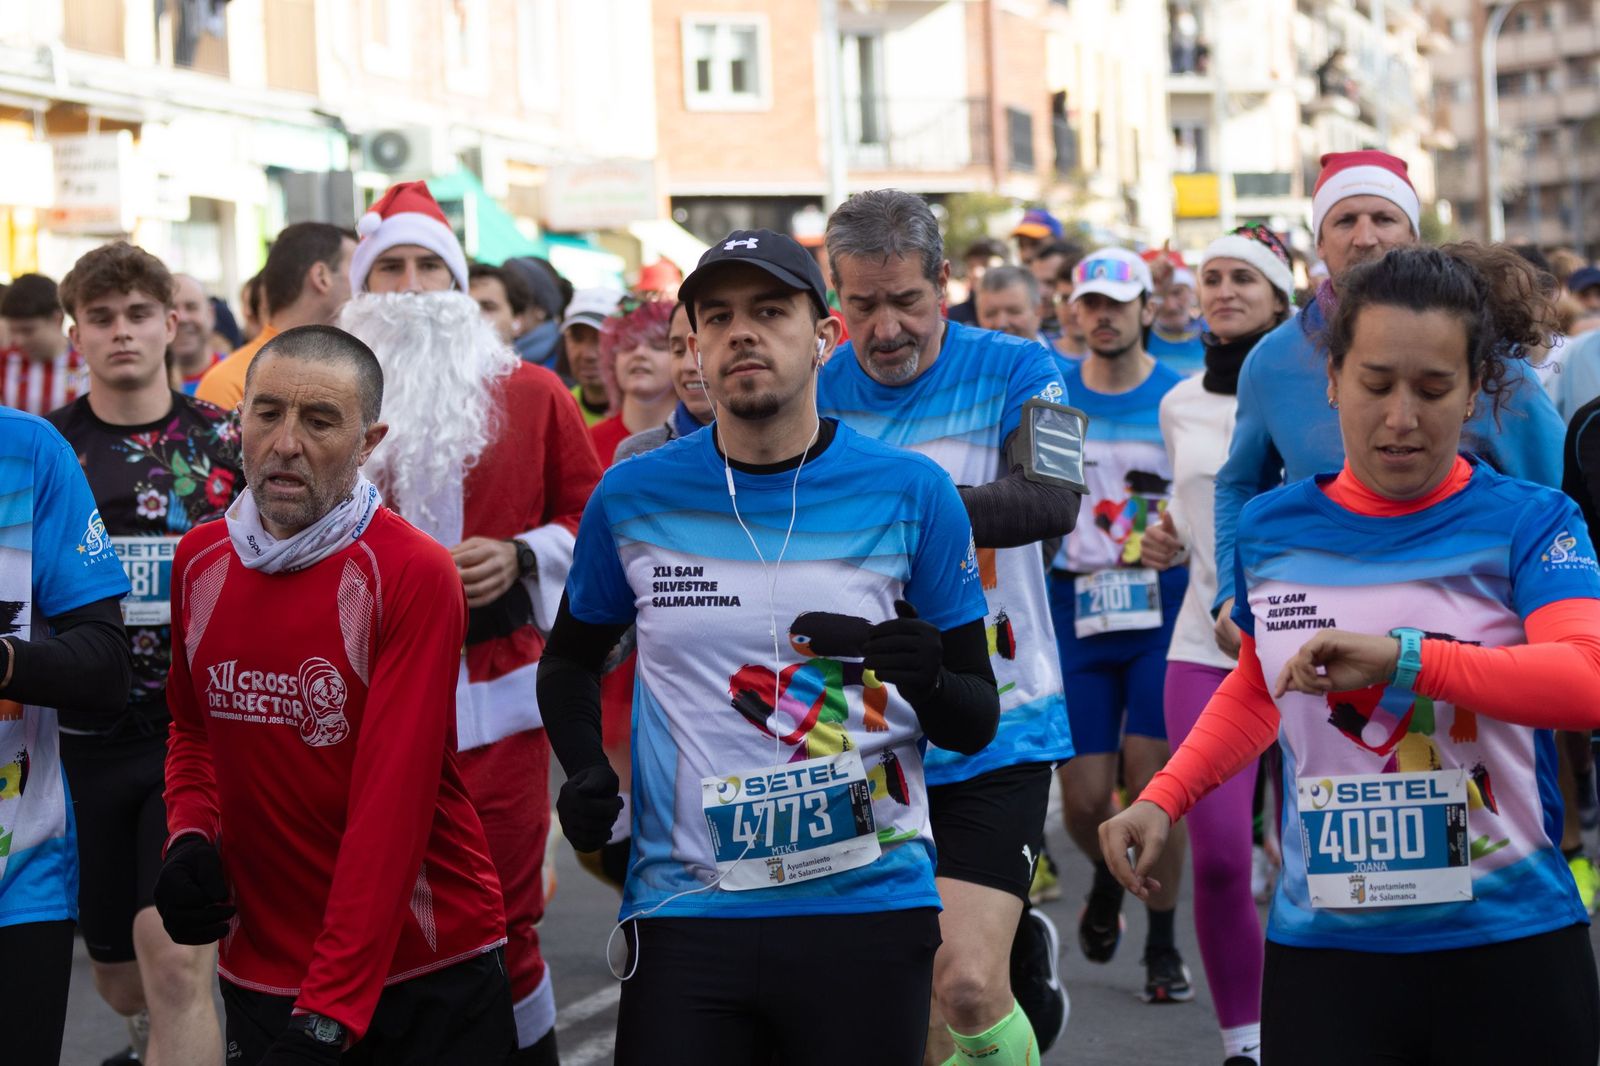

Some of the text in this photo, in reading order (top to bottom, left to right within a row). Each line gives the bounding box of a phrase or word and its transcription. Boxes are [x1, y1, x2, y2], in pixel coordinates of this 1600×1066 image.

[652, 565, 704, 578] XLI SAN
[122, 561, 159, 597] 81
[652, 581, 719, 593] SILVESTRE
[651, 595, 741, 608] SALMANTINA
[1089, 584, 1132, 613] 2101
[1282, 592, 1307, 604] SAN
[1266, 605, 1318, 619] SILVESTRE
[204, 659, 299, 697] XII CROSS
[208, 691, 305, 720] DEL RECTOR
[243, 714, 267, 724] CAMILO
[267, 715, 285, 725] JOSÉ
[285, 717, 299, 727] CELA
[744, 763, 849, 797] SETEL
[1336, 779, 1449, 804] SETEL
[732, 790, 834, 850] 4773
[1318, 807, 1426, 864] 4090
[771, 843, 799, 857] MIKI
[787, 855, 831, 871] Ayuntamiento
[1353, 861, 1389, 873] JOANA
[788, 865, 833, 880] de Salamanca
[1369, 882, 1417, 892] Ayuntamiento
[1369, 892, 1417, 901] de Salamanca
